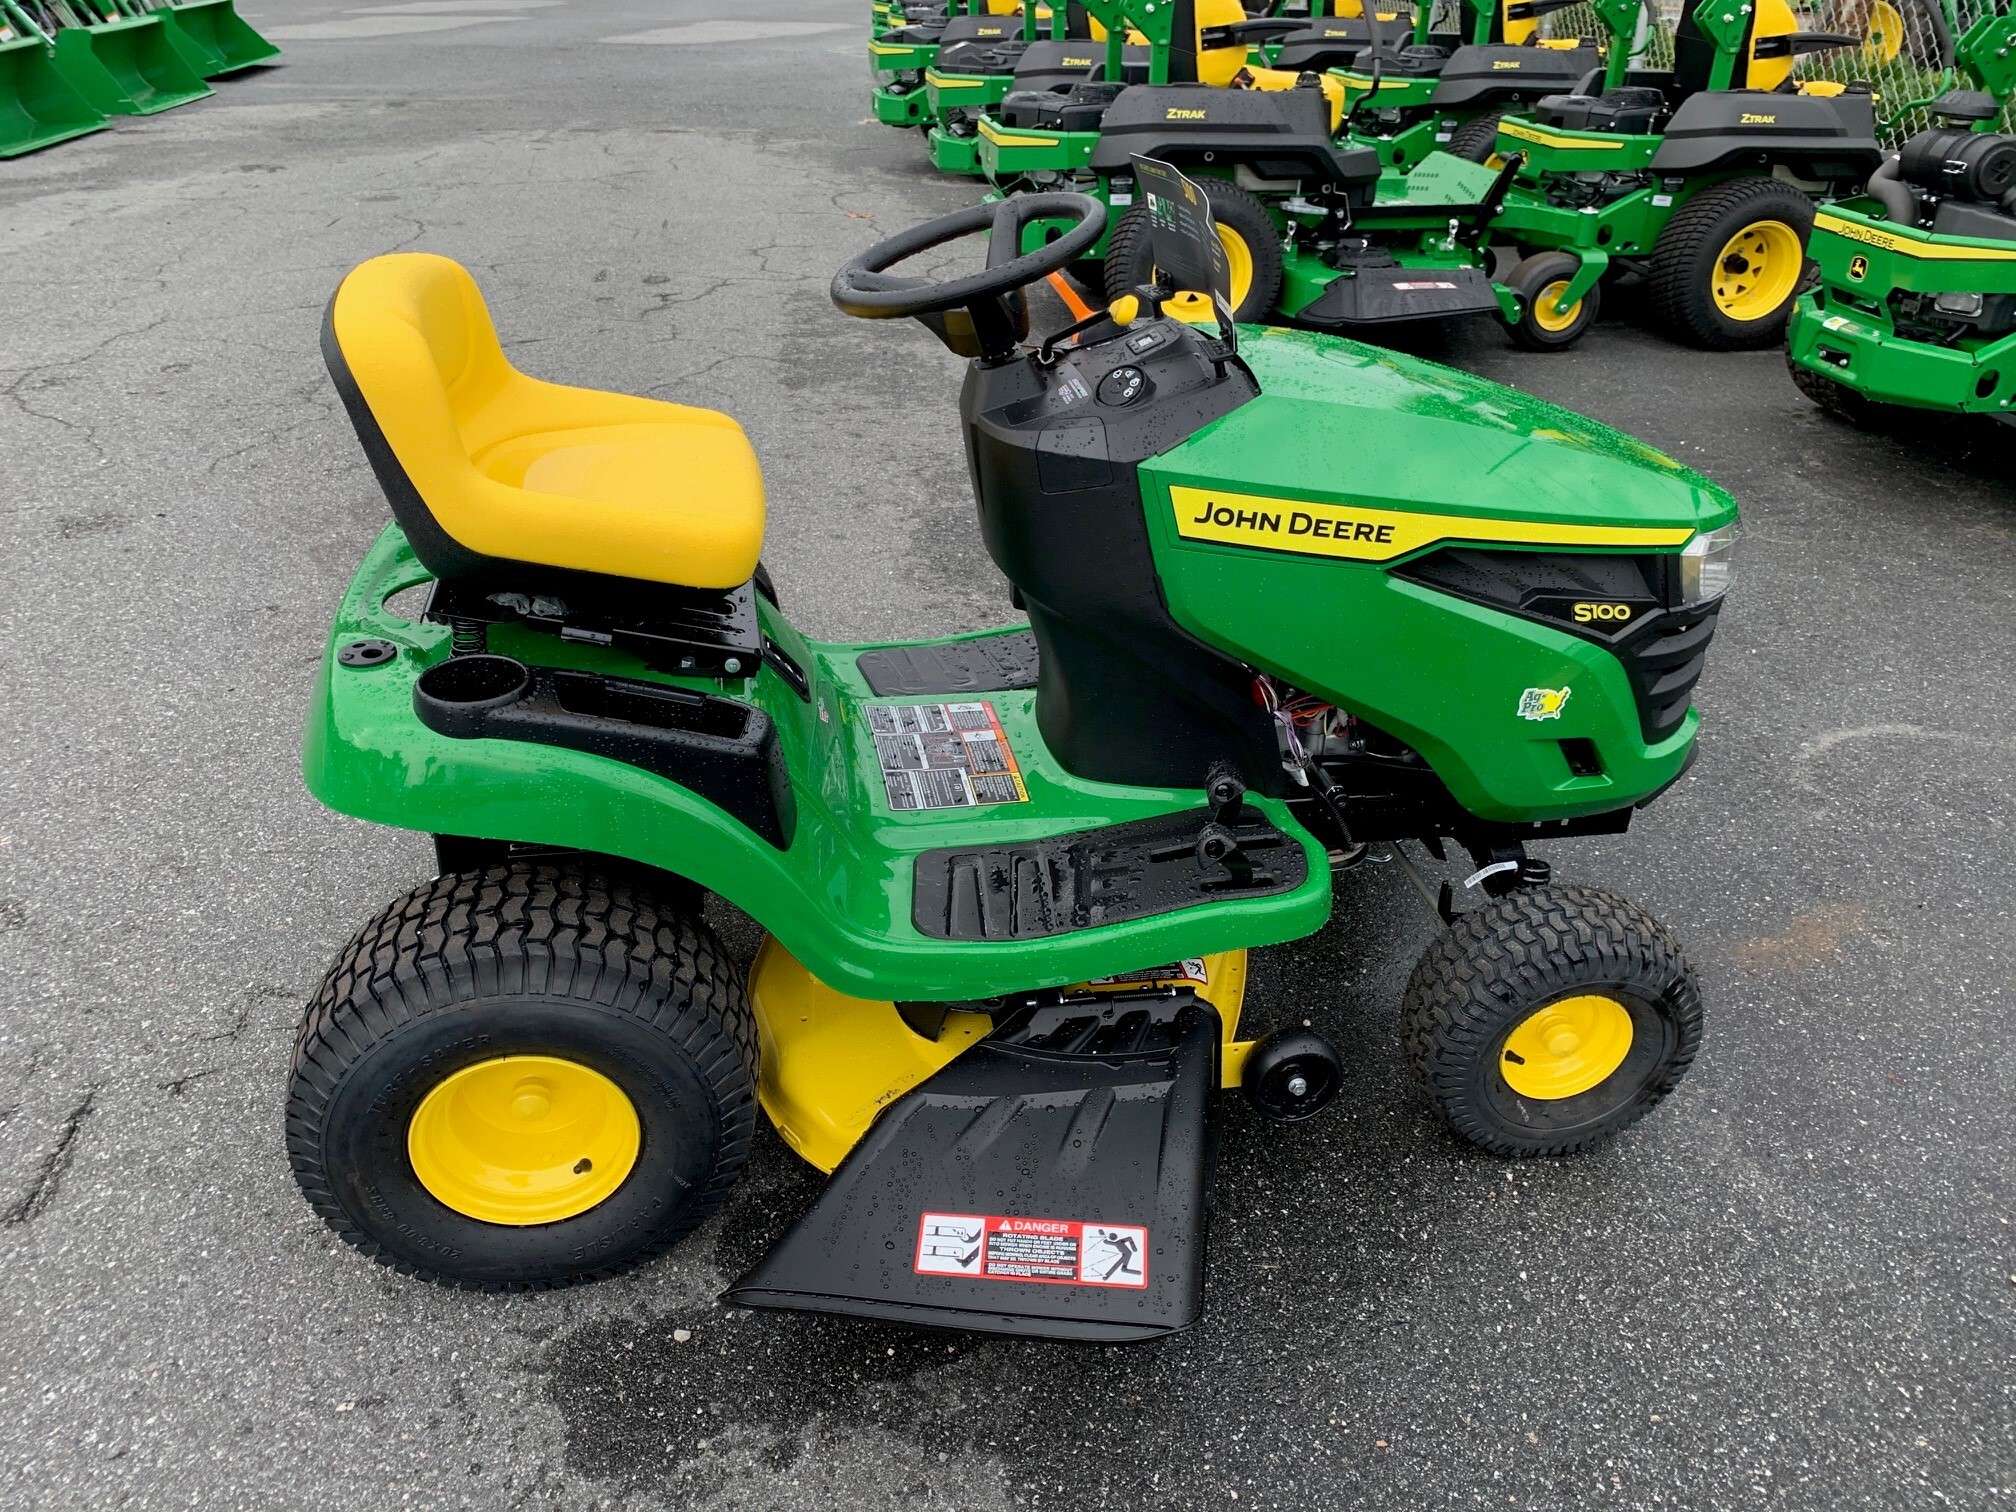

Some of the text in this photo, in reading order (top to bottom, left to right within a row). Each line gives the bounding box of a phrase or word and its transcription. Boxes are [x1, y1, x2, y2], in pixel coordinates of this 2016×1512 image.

[1062, 57, 1092, 66] ZTRAK
[1492, 61, 1520, 70] ZTRAK
[1166, 108, 1206, 119] ZTRAK
[1740, 113, 1776, 123] ZTRAK
[1838, 223, 1895, 249] JOHN DEERE
[1194, 502, 1395, 544] JOHN DEERE
[1574, 603, 1631, 622] S100
[1523, 691, 1546, 704] Ag-
[1521, 702, 1544, 713] Pro
[1014, 1221, 1069, 1234] DANGER
